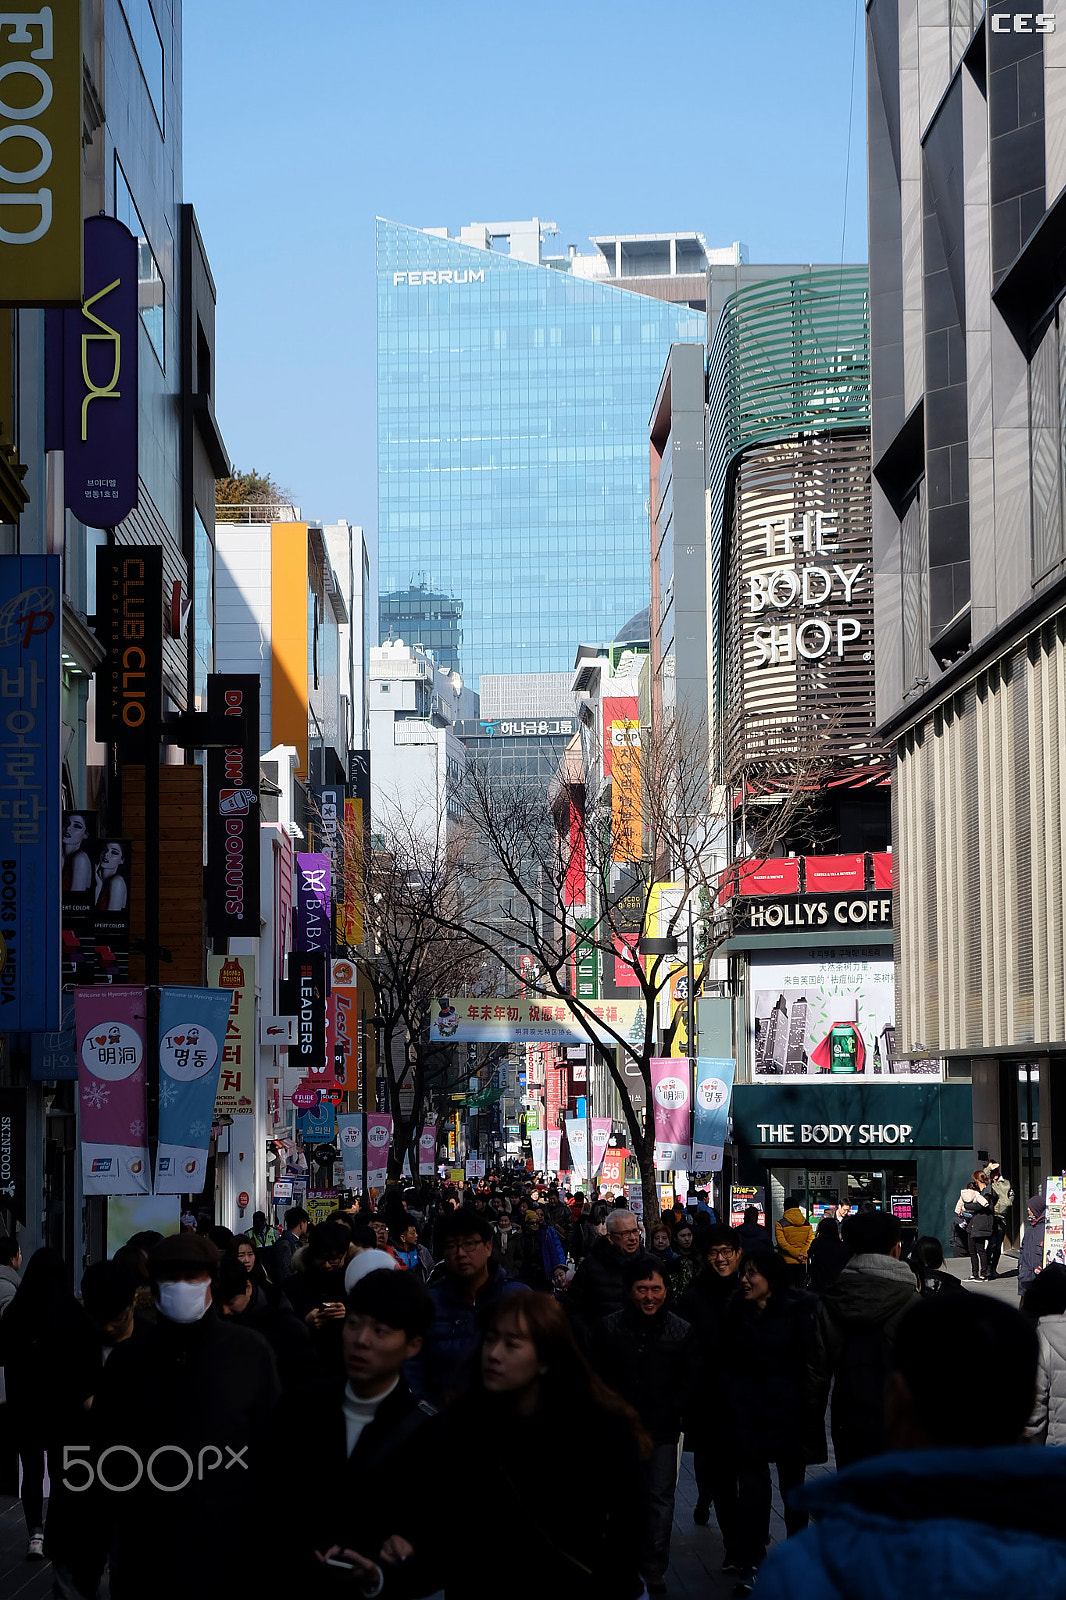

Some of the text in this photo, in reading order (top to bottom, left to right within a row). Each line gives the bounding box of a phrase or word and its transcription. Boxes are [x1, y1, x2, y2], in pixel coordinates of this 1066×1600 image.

[0, 5, 54, 245] FOOD
[393, 268, 485, 287] FERRUM
[81, 278, 121, 442] VDL
[86, 479, 117, 488] 브이디엘
[759, 511, 840, 557] THE
[750, 563, 866, 612] BODY
[111, 566, 119, 720] PROFESSIONAL
[122, 558, 146, 728] CLUB CLIO
[752, 618, 863, 667] SHOP
[0, 658, 48, 844] 바오로딸
[224, 689, 243, 786] DUKIN'
[500, 720, 573, 736] 하나금융그룹
[2, 860, 17, 922] BOOKS
[750, 902, 829, 927] HOLLYS
[1, 947, 17, 1003] MEDIA
[300, 976, 313, 1055] LEADERS
[87, 1038, 96, 1051] I
[98, 1046, 137, 1065] 明洞
[165, 1036, 174, 1049] I
[174, 1048, 208, 1068] 명동
[704, 1091, 723, 1104] 명동
[0, 1116, 11, 1181] SKINFOOD
[756, 1123, 795, 1143] THE
[800, 1123, 855, 1143] BODY
[602, 1167, 620, 1180] 50
